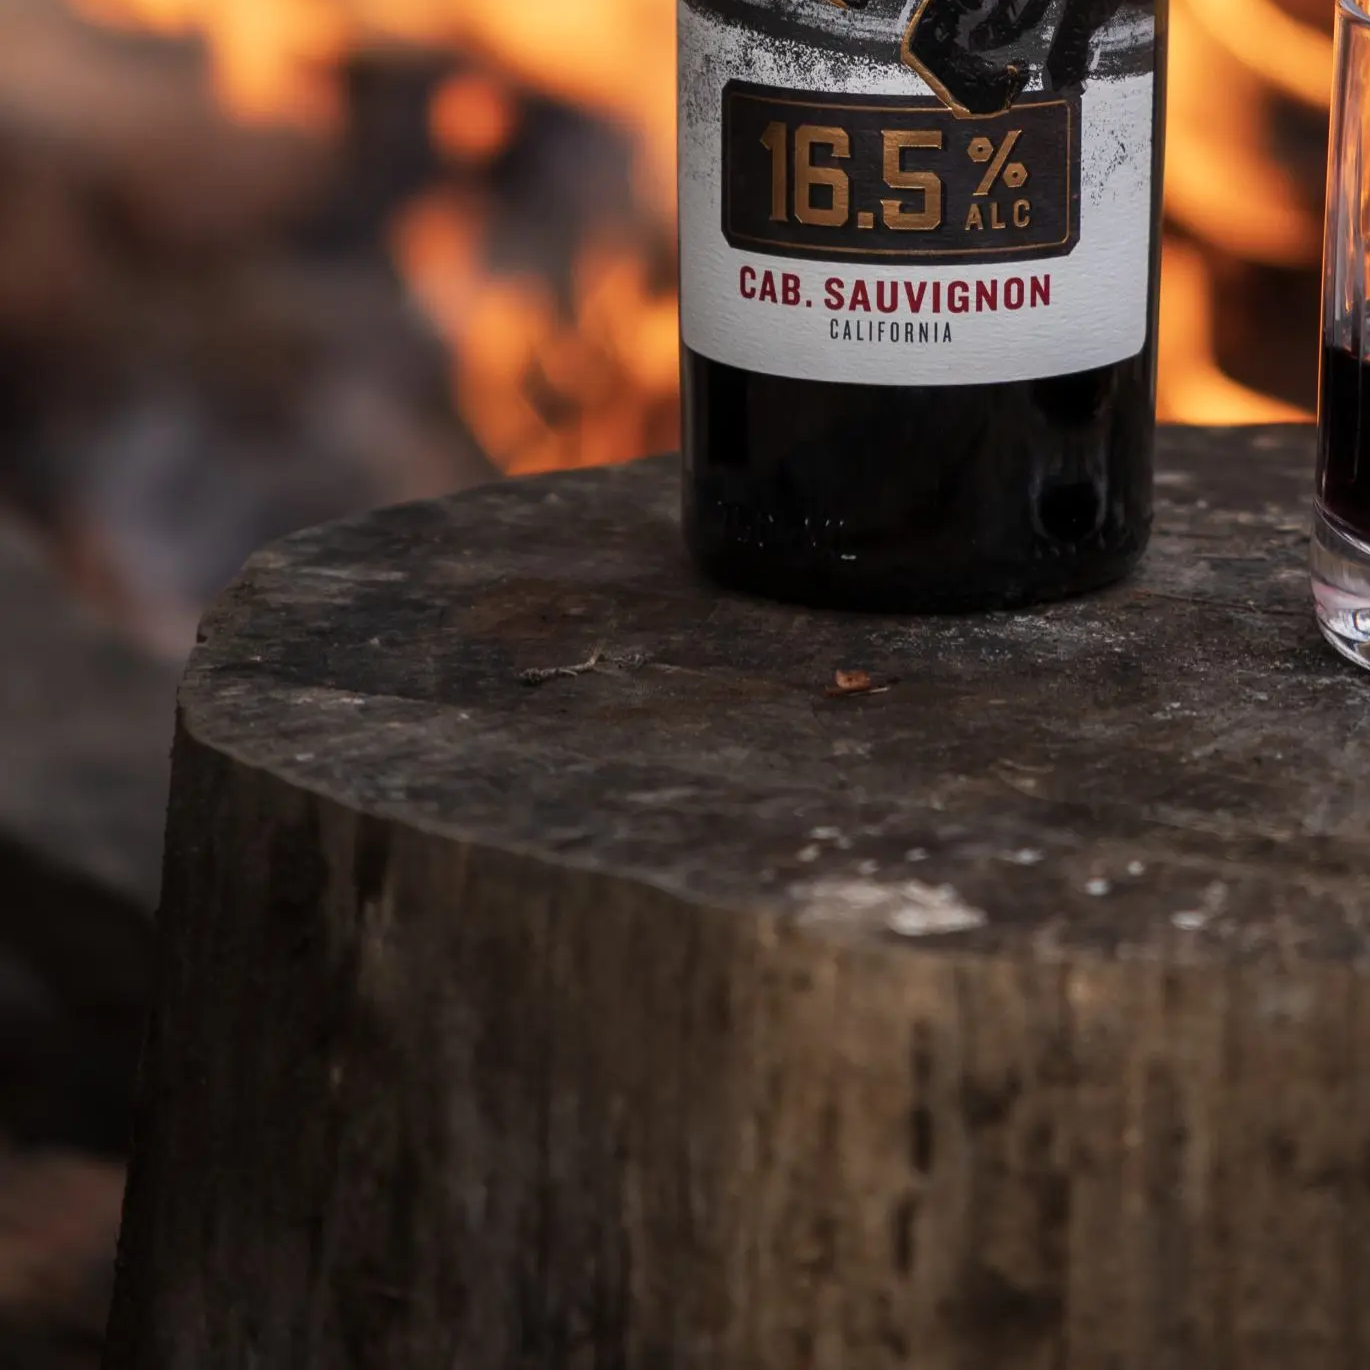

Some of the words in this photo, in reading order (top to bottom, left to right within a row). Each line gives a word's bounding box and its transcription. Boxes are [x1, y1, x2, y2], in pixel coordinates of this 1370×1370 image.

[761, 122, 941, 230] 16.5
[965, 199, 1031, 230] ALC
[739, 266, 812, 307] CAB.
[824, 274, 1051, 313] SAUVIGNON
[830, 319, 952, 343] CALIFORNIA
